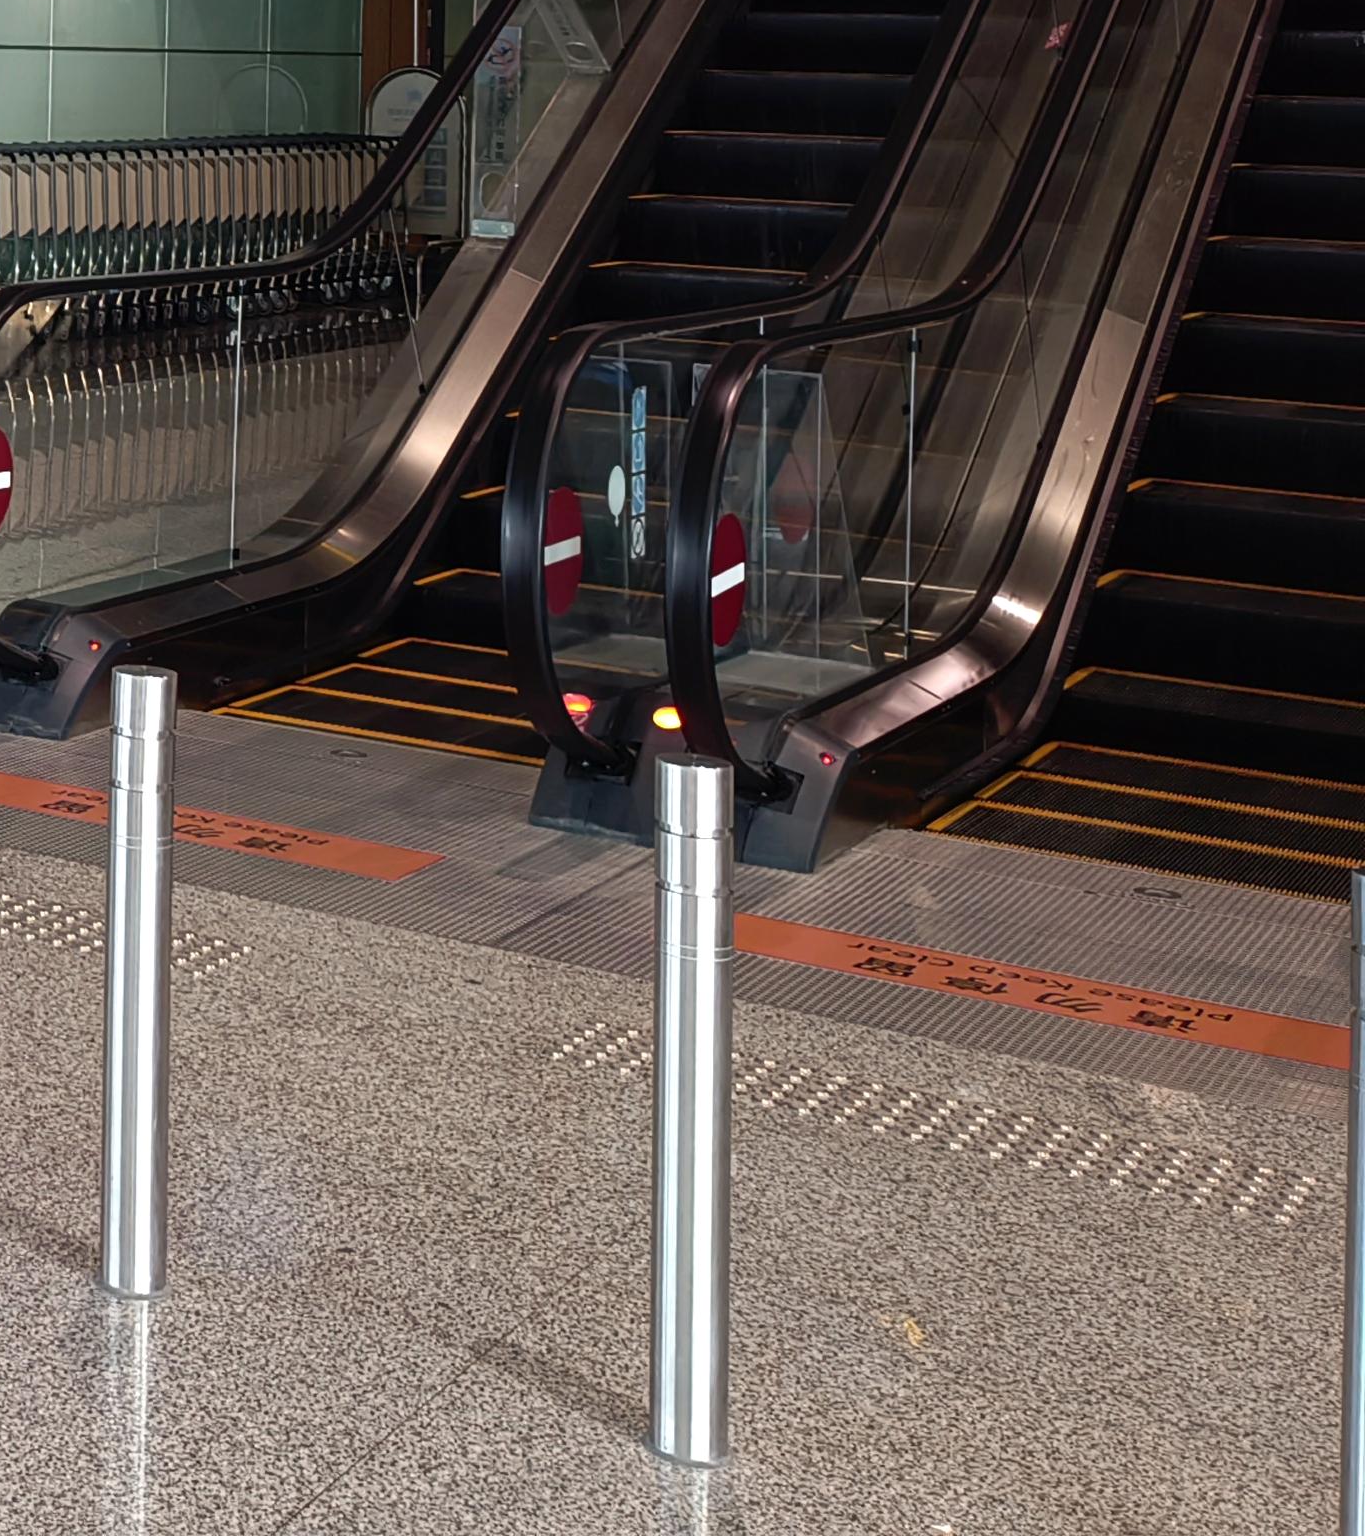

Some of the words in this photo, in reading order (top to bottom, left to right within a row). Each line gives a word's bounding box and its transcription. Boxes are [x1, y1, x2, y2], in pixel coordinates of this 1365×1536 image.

[847, 942, 955, 968] Clear
[968, 964, 1074, 992] Keep
[852, 956, 1199, 1035] 请勿停留
[1088, 988, 1234, 1022] Please
